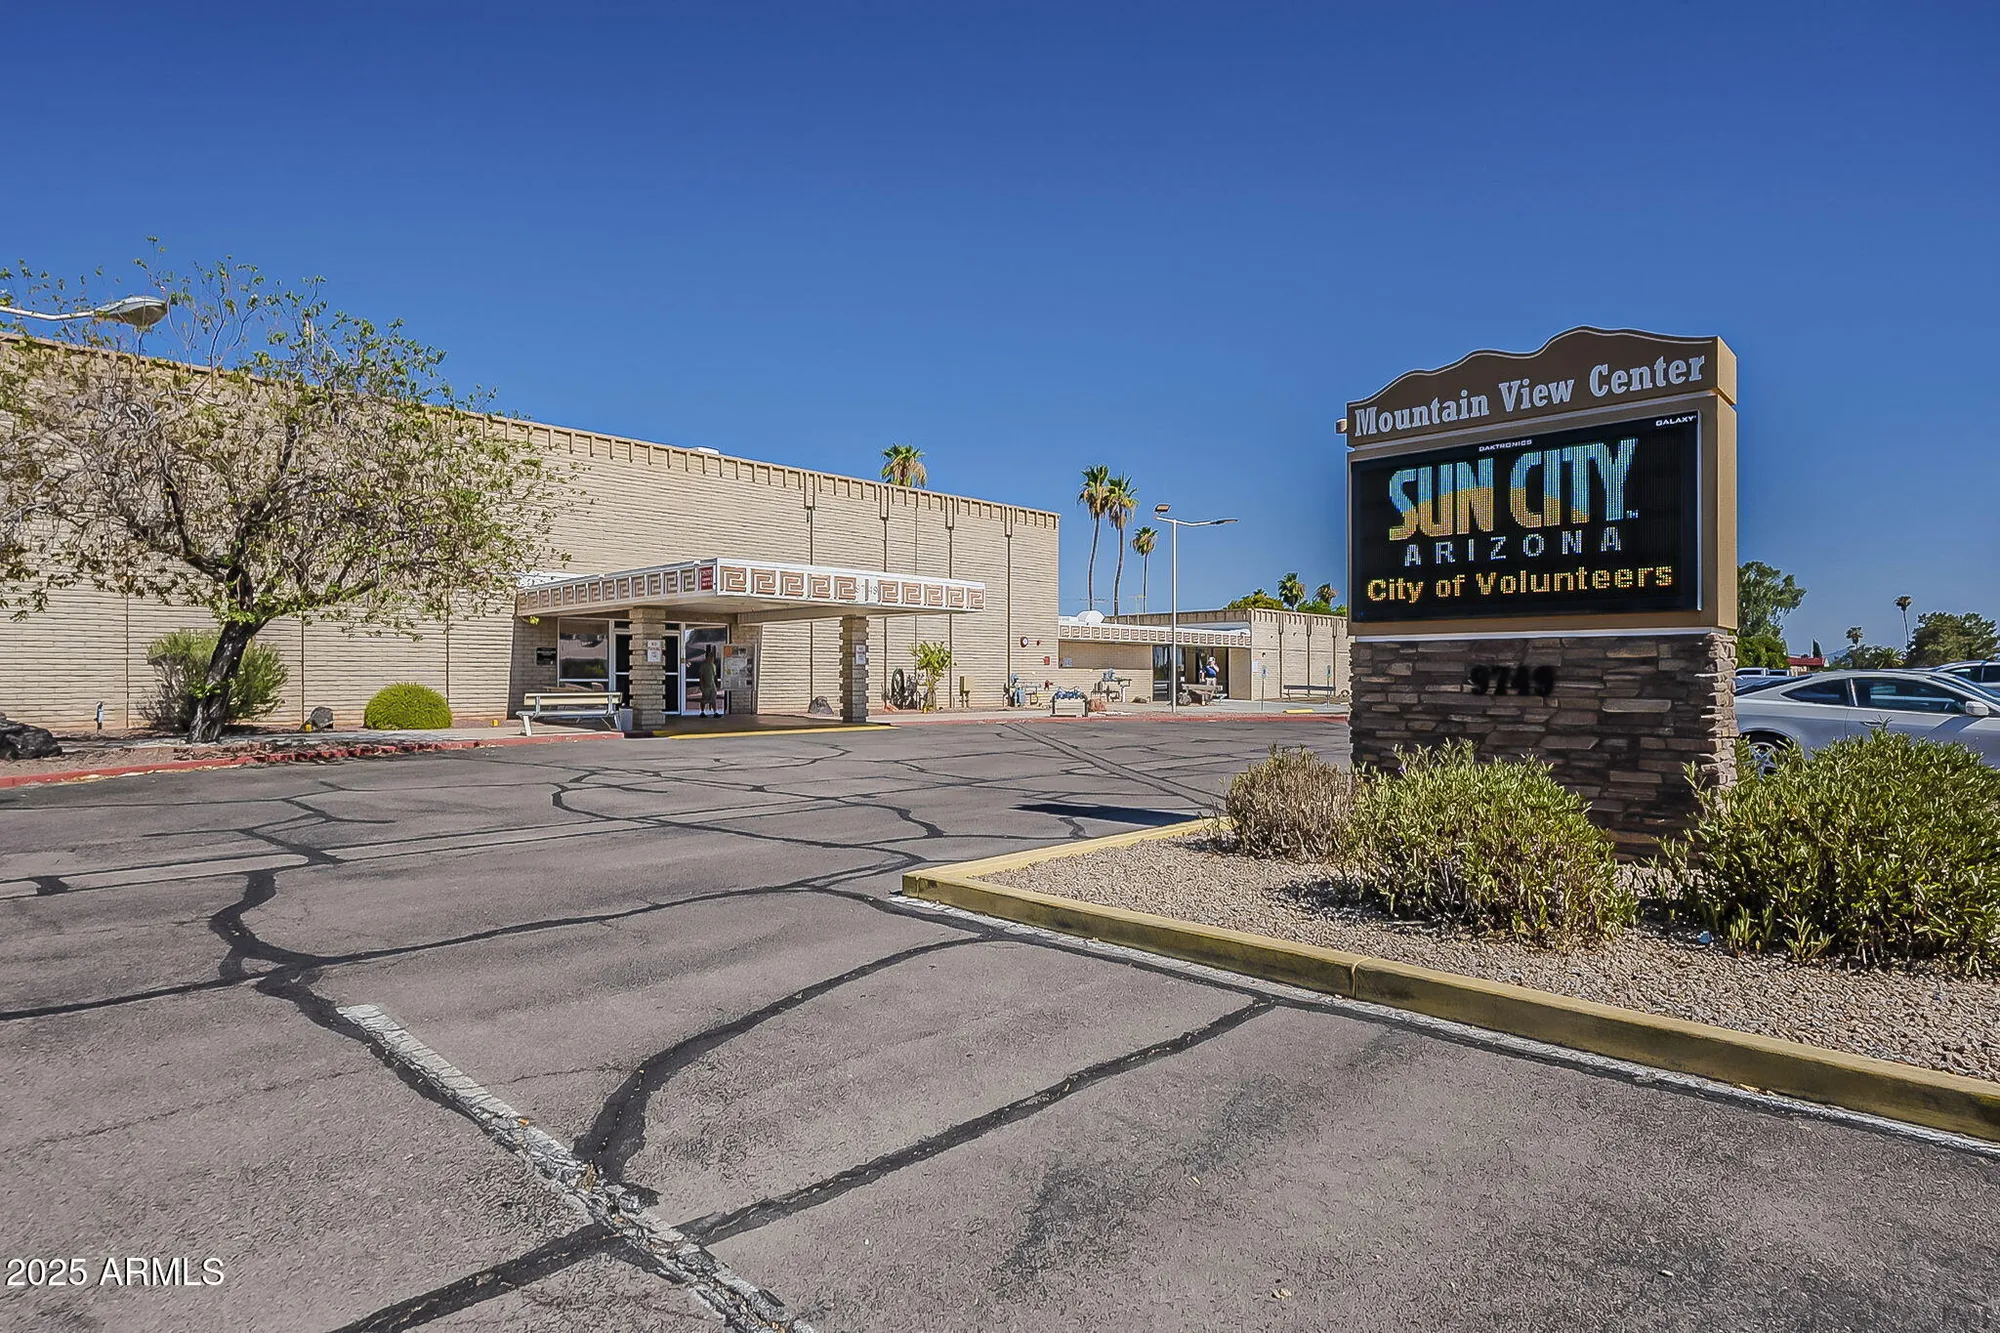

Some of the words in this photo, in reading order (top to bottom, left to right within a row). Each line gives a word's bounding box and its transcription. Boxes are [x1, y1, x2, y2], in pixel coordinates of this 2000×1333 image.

[1355, 389, 1490, 437] Mountain
[1499, 378, 1575, 413] View
[1589, 355, 1705, 397] Center
[1655, 415, 1694, 427] GALAXY
[1478, 439, 1533, 452] DAKTRONICS
[1388, 457, 1494, 541] SUN
[1509, 437, 1639, 529] CITY
[1404, 526, 1622, 567] ARIZONA
[1367, 578, 1424, 603] City
[1435, 573, 1466, 597] of
[1475, 565, 1673, 596] Volunteers
